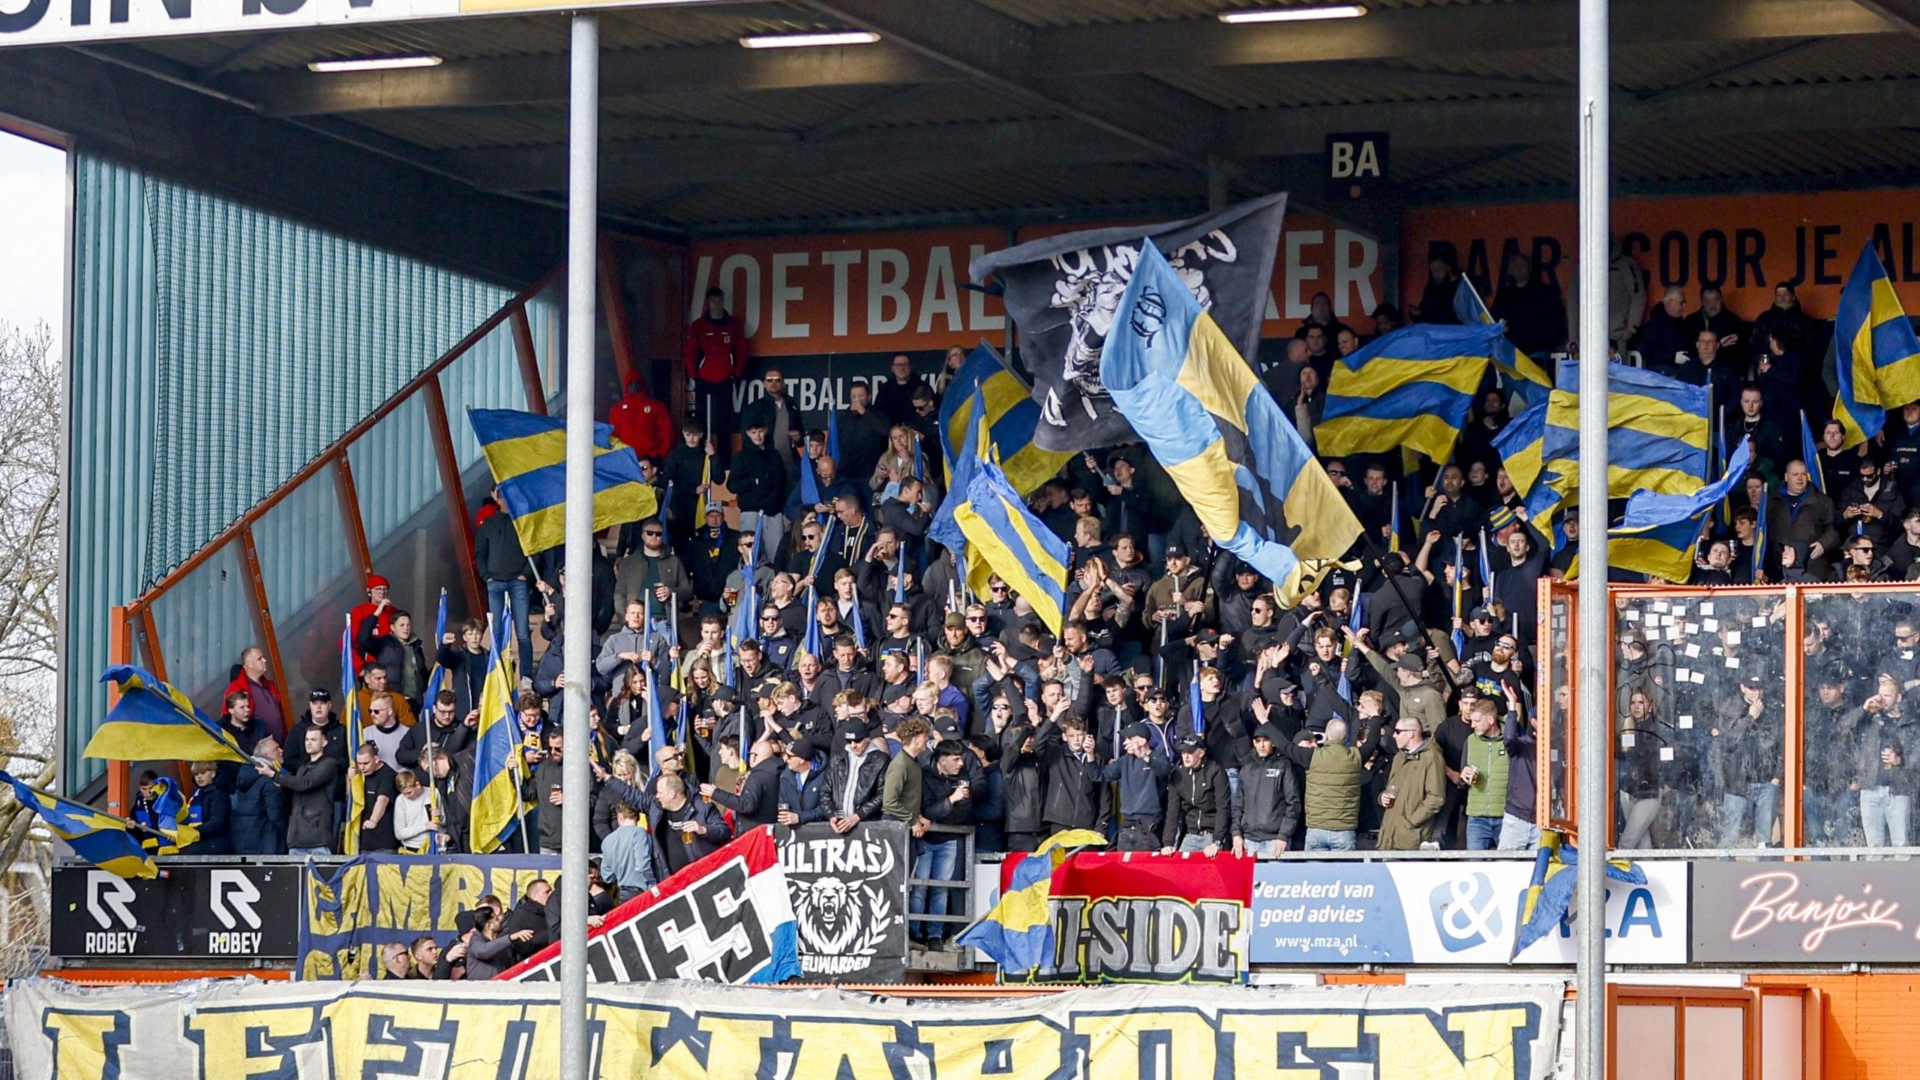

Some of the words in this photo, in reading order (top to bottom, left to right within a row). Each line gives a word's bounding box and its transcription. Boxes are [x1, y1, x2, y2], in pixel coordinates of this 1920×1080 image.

[1331, 141, 1380, 178] BA
[1789, 225, 1842, 285] JE
[1264, 229, 1379, 319] ER
[1254, 880, 1341, 898] Verzekerd
[1344, 884, 1374, 898] van
[1260, 905, 1305, 927] goed
[1307, 905, 1364, 923] advies
[1731, 871, 1903, 951] Banjo's
[85, 932, 137, 954] ROBEY
[209, 932, 262, 954] ROBEY
[1275, 935, 1358, 949] www.mza.nl
[799, 955, 871, 974] EUWARDEN
